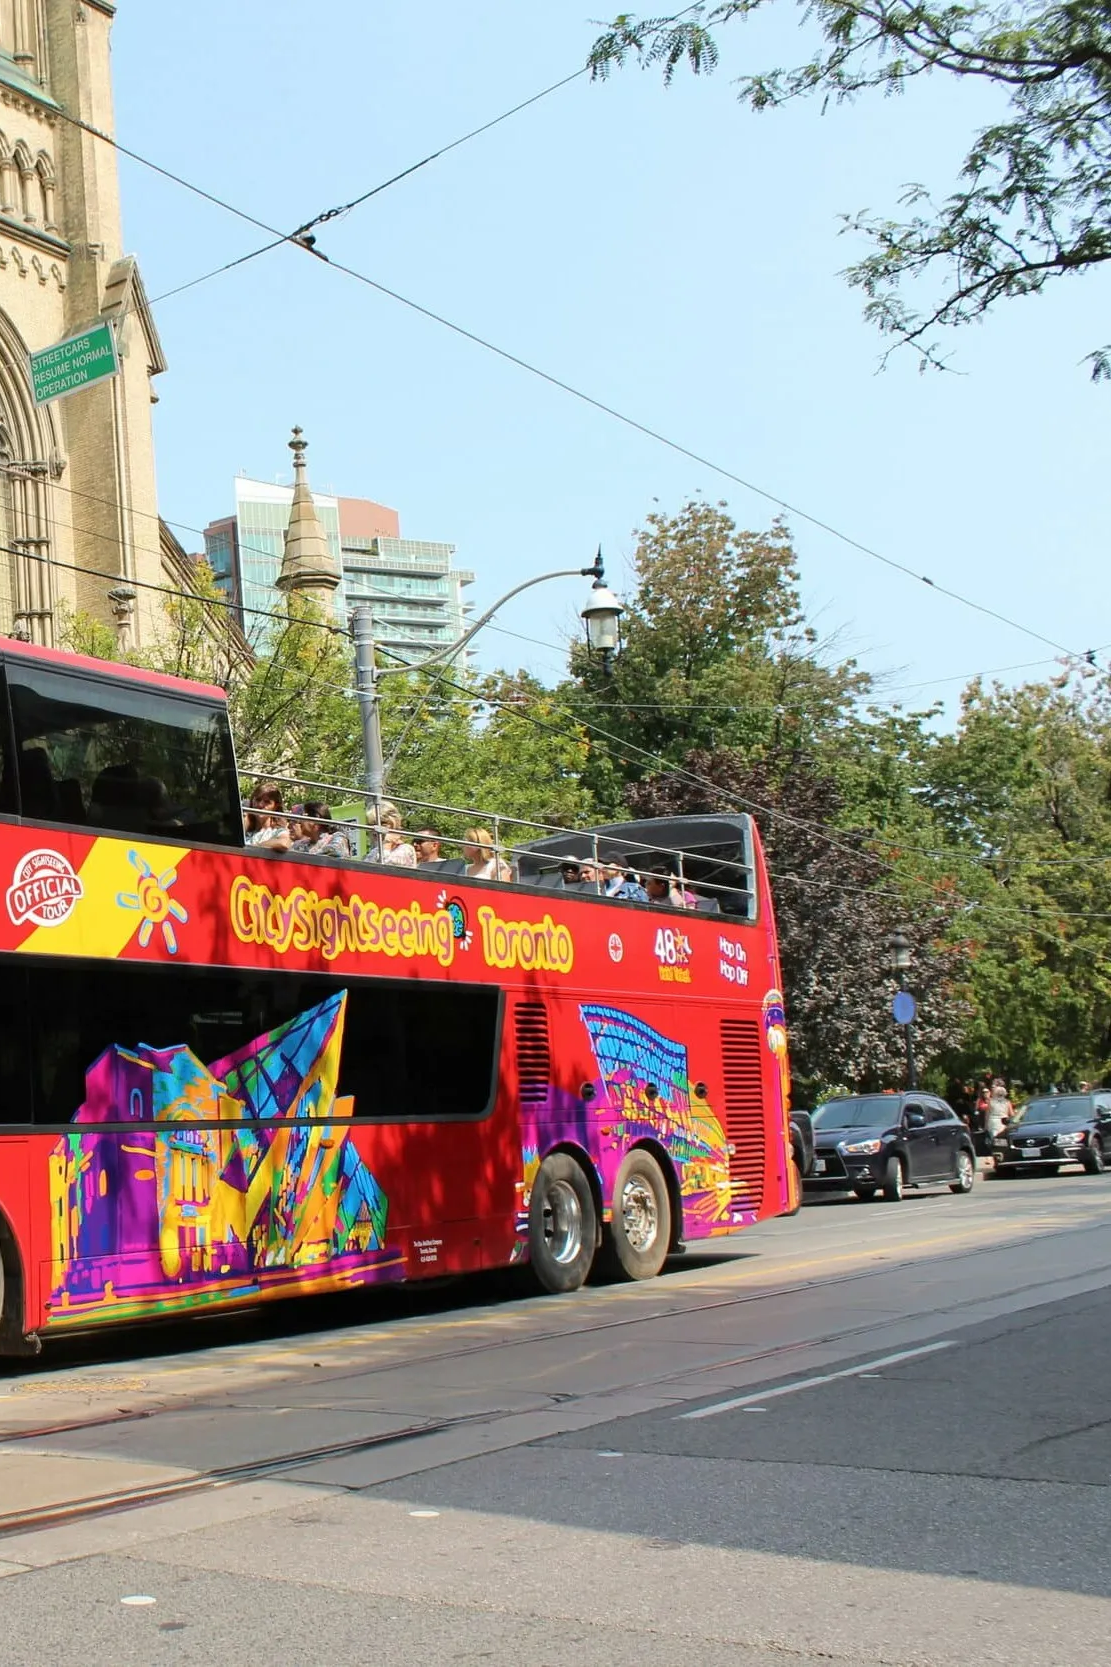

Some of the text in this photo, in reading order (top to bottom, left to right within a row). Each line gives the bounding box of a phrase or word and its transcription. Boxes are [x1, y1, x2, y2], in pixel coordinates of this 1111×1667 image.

[31, 337, 91, 371] STREETCARS
[34, 344, 112, 385] RESUME NORMAL
[36, 369, 88, 399] OPERATION
[13, 877, 80, 913] OFFICIAL
[41, 899, 69, 919] TOUR
[478, 906, 573, 973] Toronto
[654, 928, 677, 964] 48
[719, 935, 747, 963] Hop On
[719, 959, 749, 985] Hop Off
